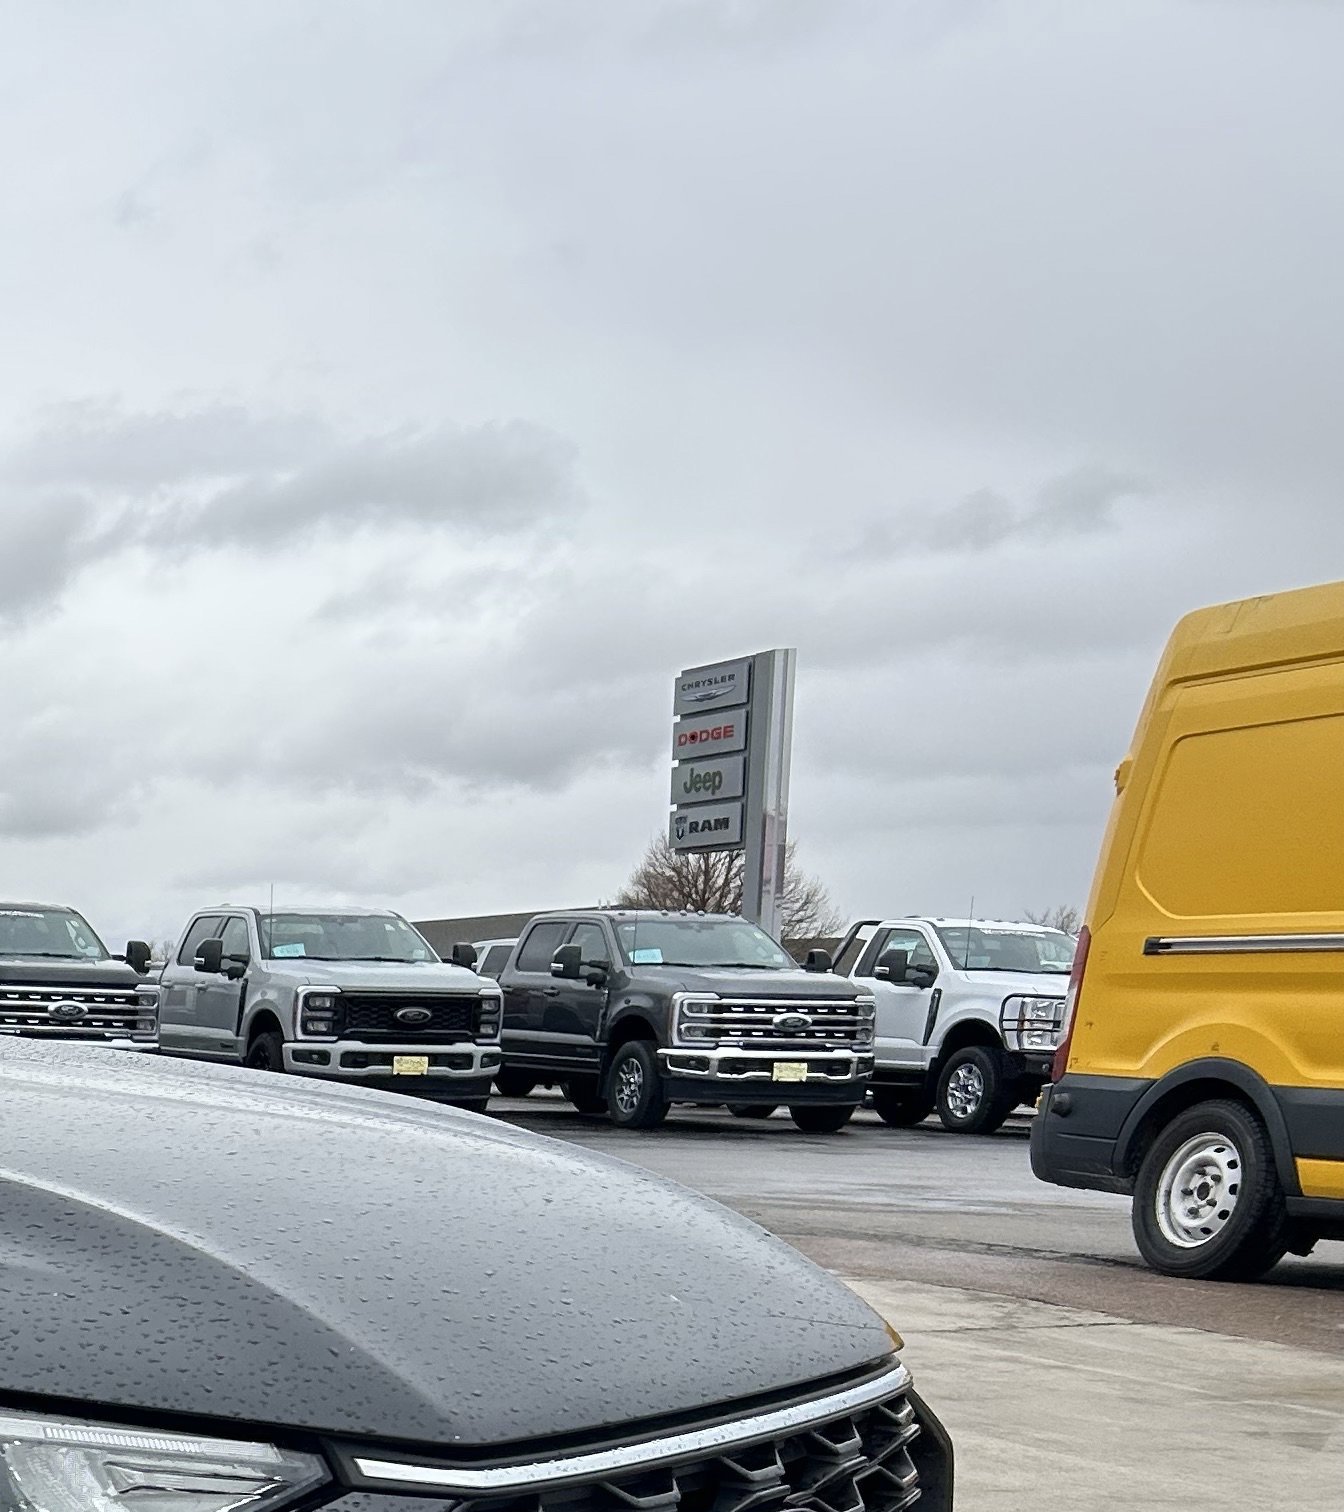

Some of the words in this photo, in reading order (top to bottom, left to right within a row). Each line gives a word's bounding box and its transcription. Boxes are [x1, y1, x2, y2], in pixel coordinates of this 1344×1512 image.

[681, 673, 736, 692] CHRYSLER
[677, 724, 735, 747] DODGE
[683, 767, 723, 795] Jeep
[688, 816, 730, 834] RAM
